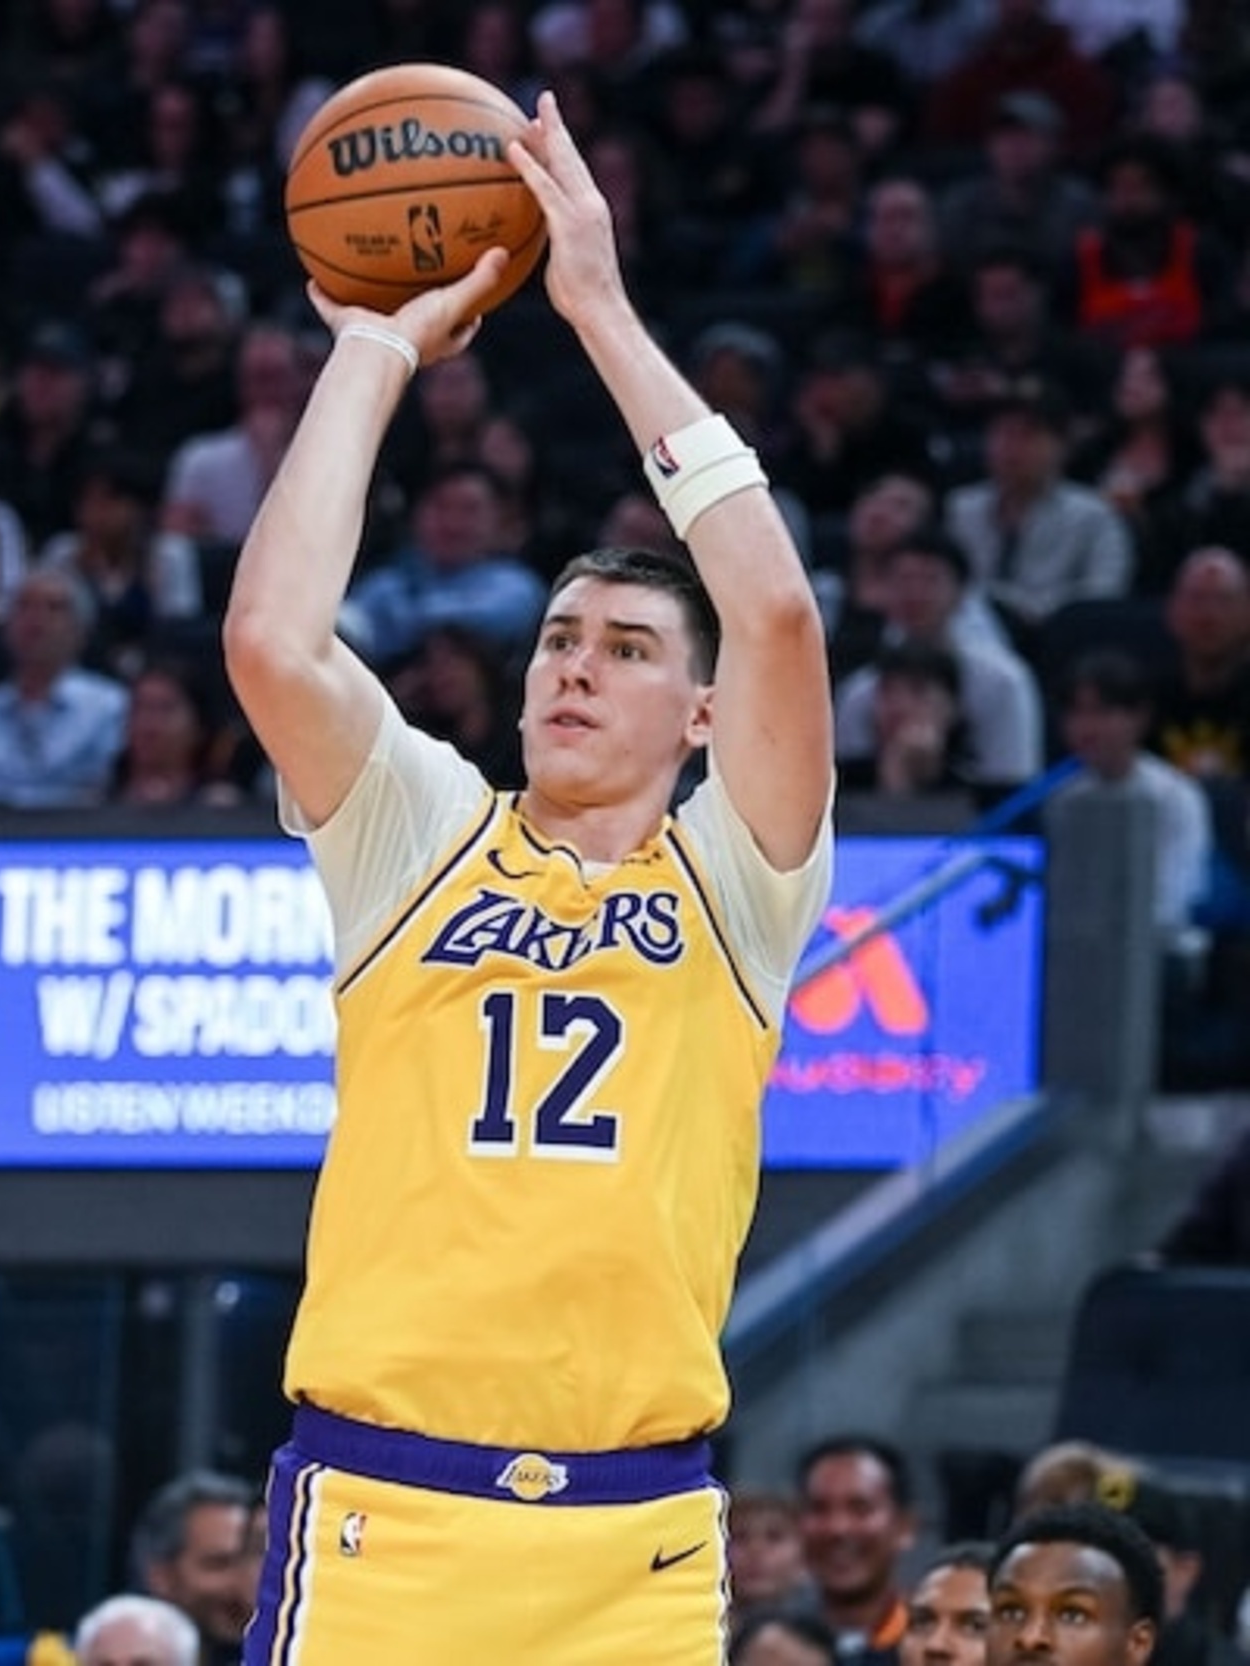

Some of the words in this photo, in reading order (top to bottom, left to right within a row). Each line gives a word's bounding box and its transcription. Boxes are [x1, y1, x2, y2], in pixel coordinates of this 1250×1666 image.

[328, 117, 506, 178] Wilson
[38, 972, 133, 1056] W/
[34, 1083, 179, 1133] LISTEN
[470, 988, 623, 1158] 12
